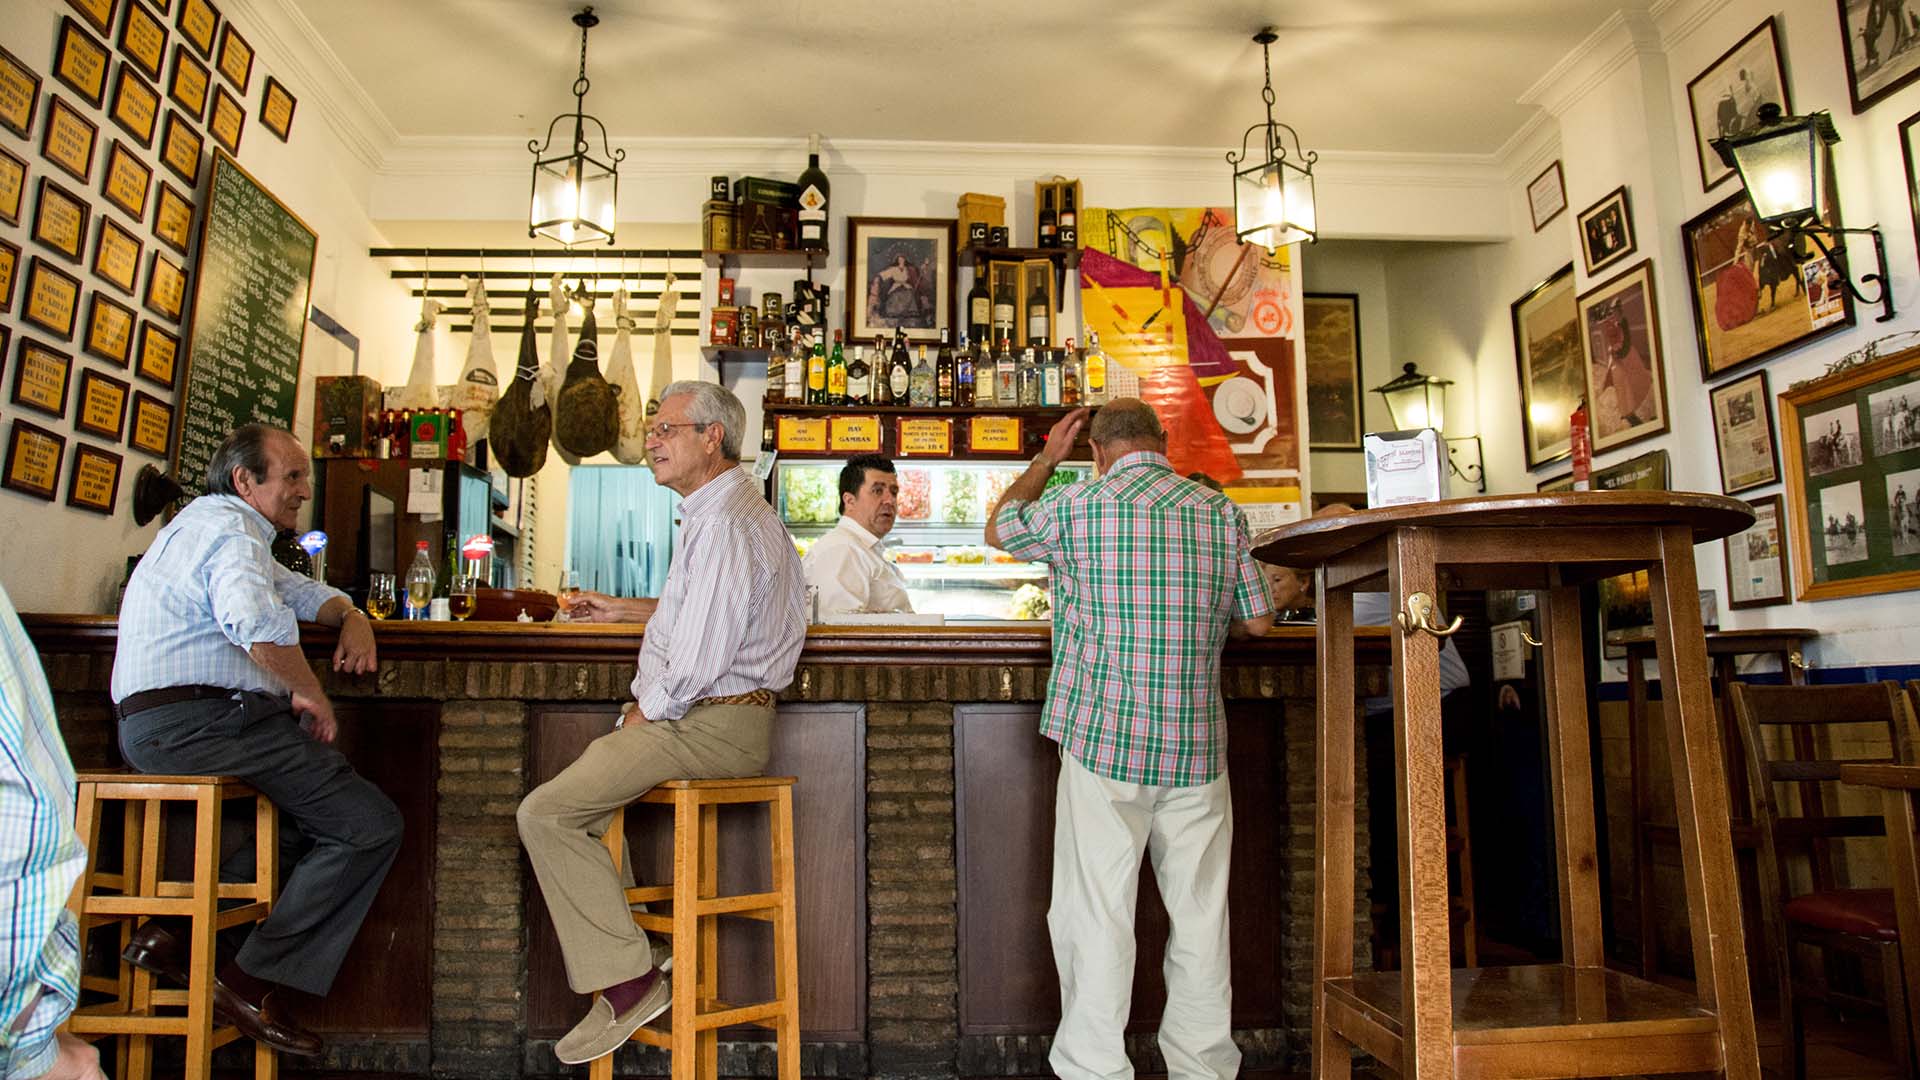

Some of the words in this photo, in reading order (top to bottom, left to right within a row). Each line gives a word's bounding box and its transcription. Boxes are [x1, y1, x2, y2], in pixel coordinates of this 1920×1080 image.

[713, 182, 727, 193] LC
[972, 228, 985, 239] LC
[1061, 231, 1074, 241] LC
